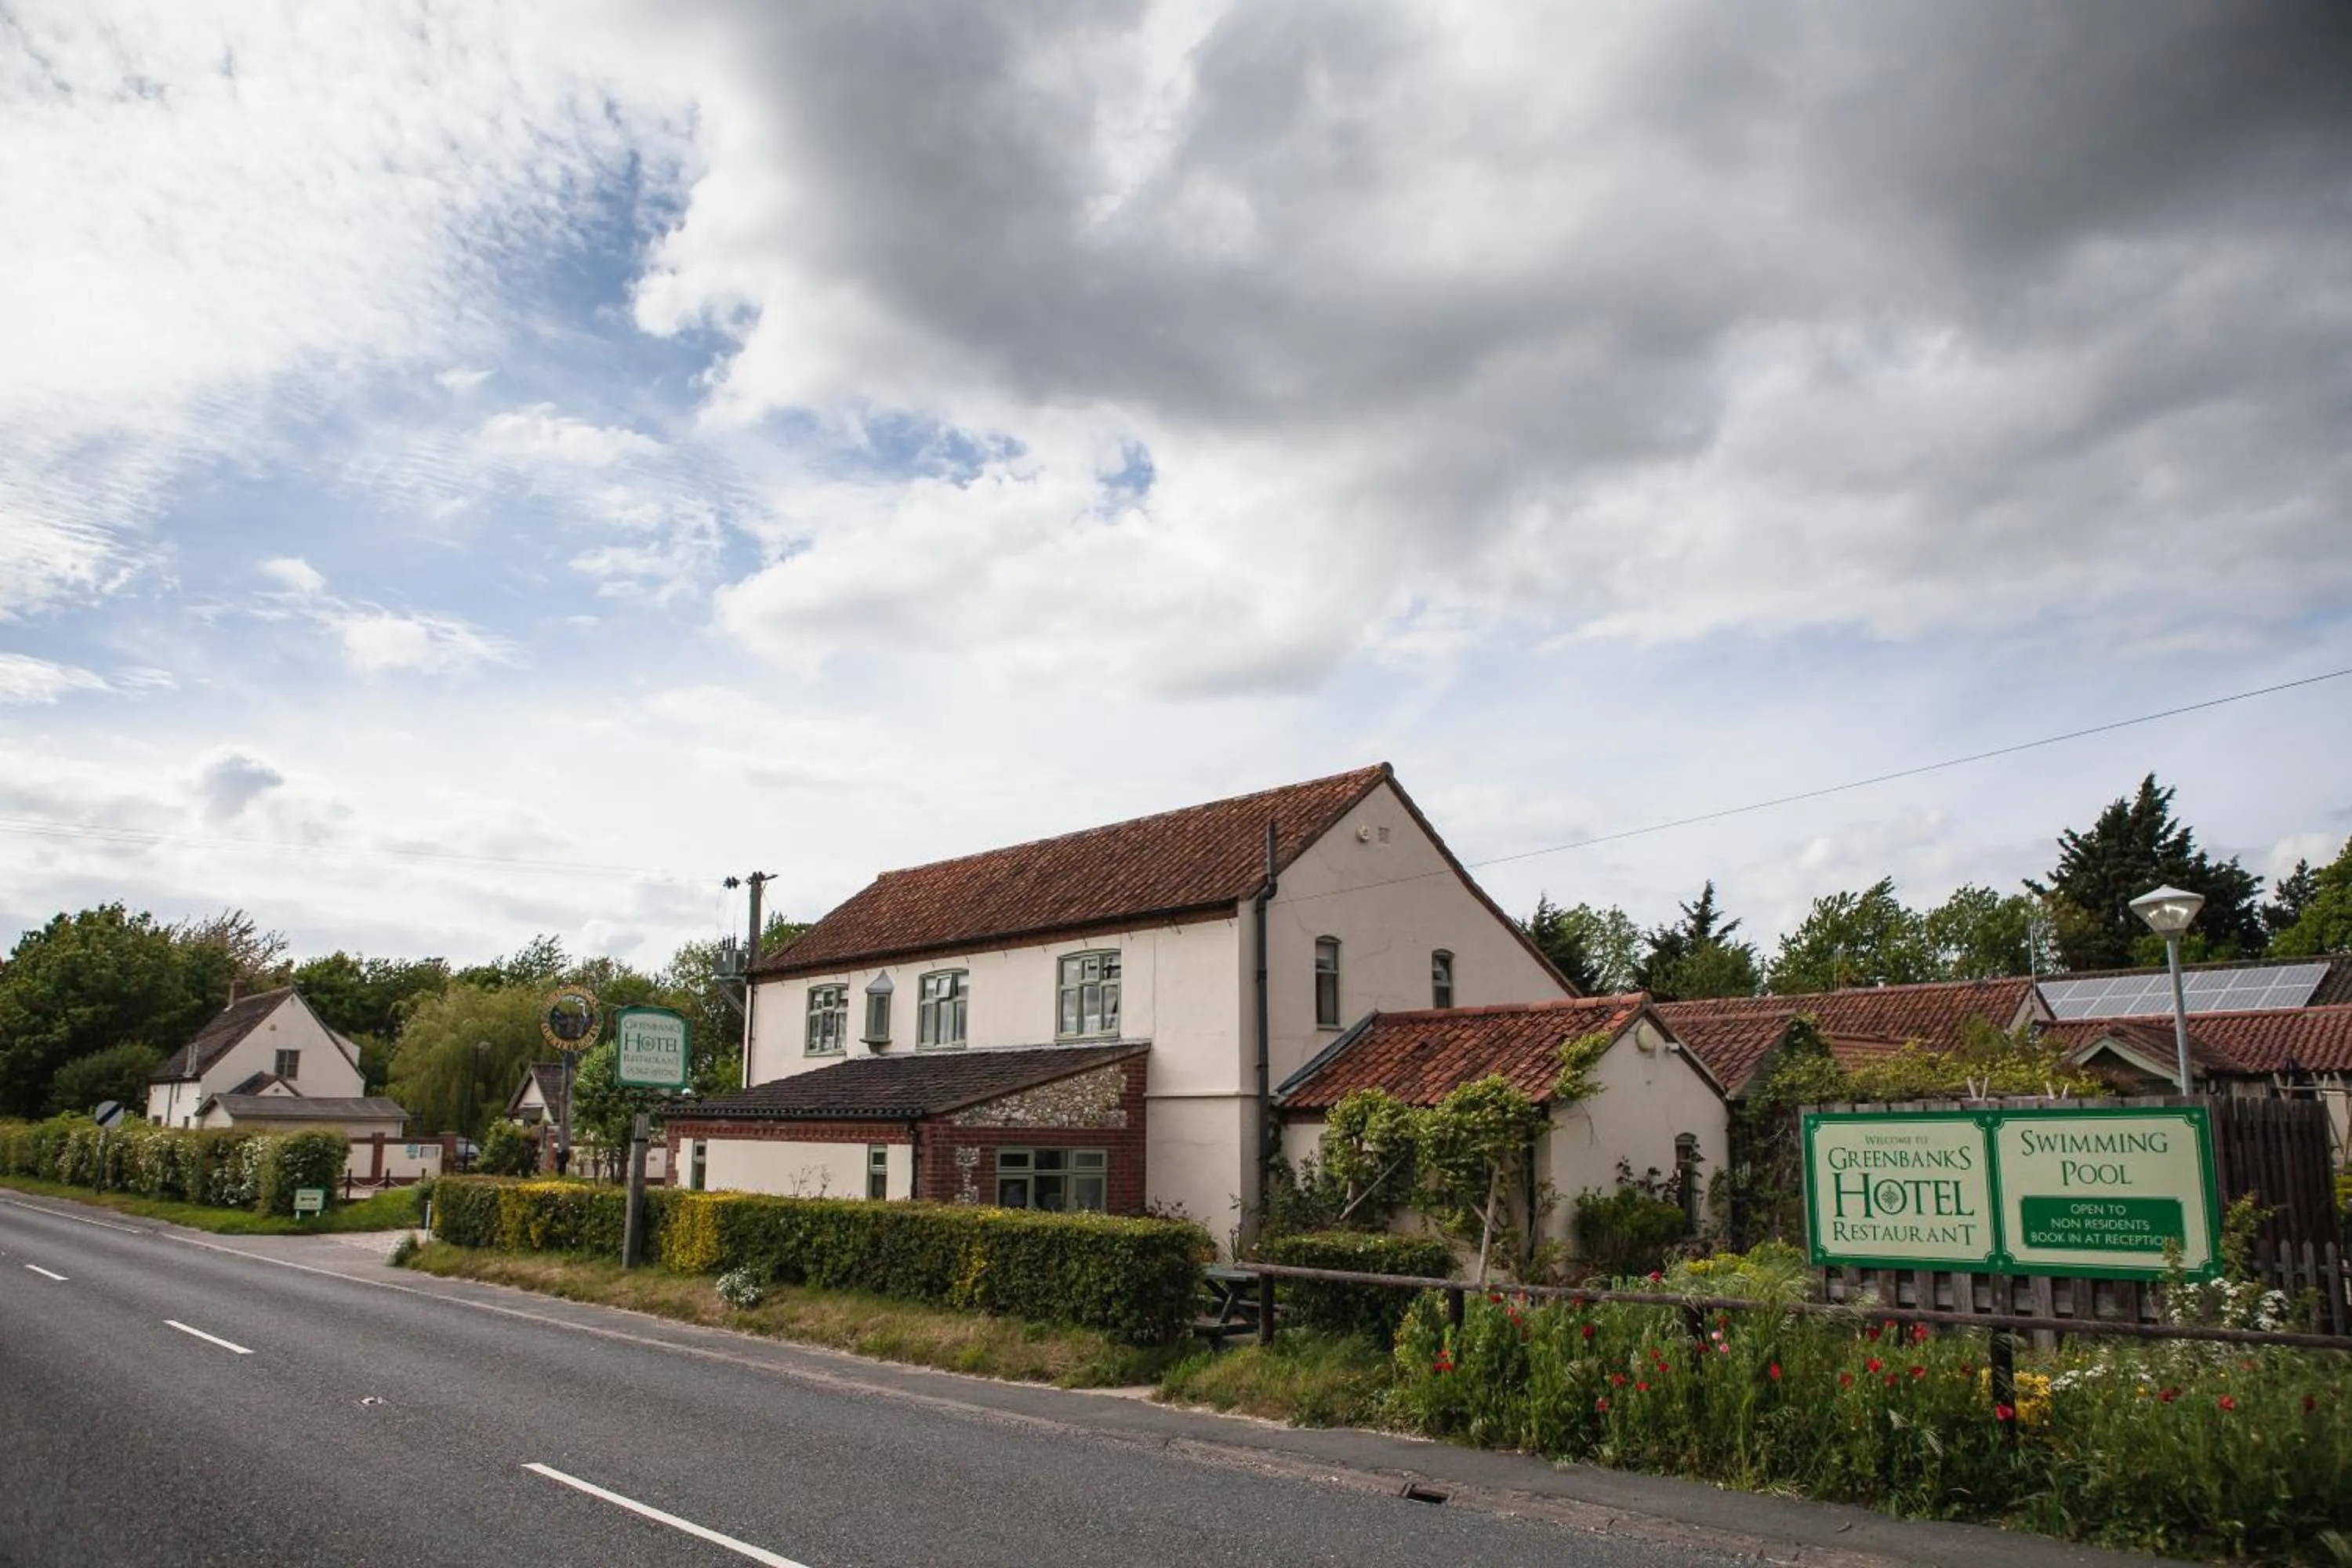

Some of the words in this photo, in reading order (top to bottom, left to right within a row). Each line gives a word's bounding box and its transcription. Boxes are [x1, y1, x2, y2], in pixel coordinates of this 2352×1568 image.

[625, 1033, 677, 1052] HOTEL
[2020, 1130, 2169, 1156] SWIMMING
[1828, 1146, 1973, 1171] GREENBANKS
[2061, 1160, 2132, 1186] POOL
[1832, 1173, 1975, 1218] HOTEL
[2070, 1203, 2104, 1214] OPEN
[2108, 1205, 2127, 1215] TO
[1833, 1221, 1976, 1246] RESTAURANT
[2050, 1218, 2082, 1229] NON
[2085, 1219, 2151, 1231] RESIDENTS
[2031, 1232, 2065, 1243] BOOK
[2068, 1233, 2082, 1243] IN
[2085, 1233, 2102, 1243] AT
